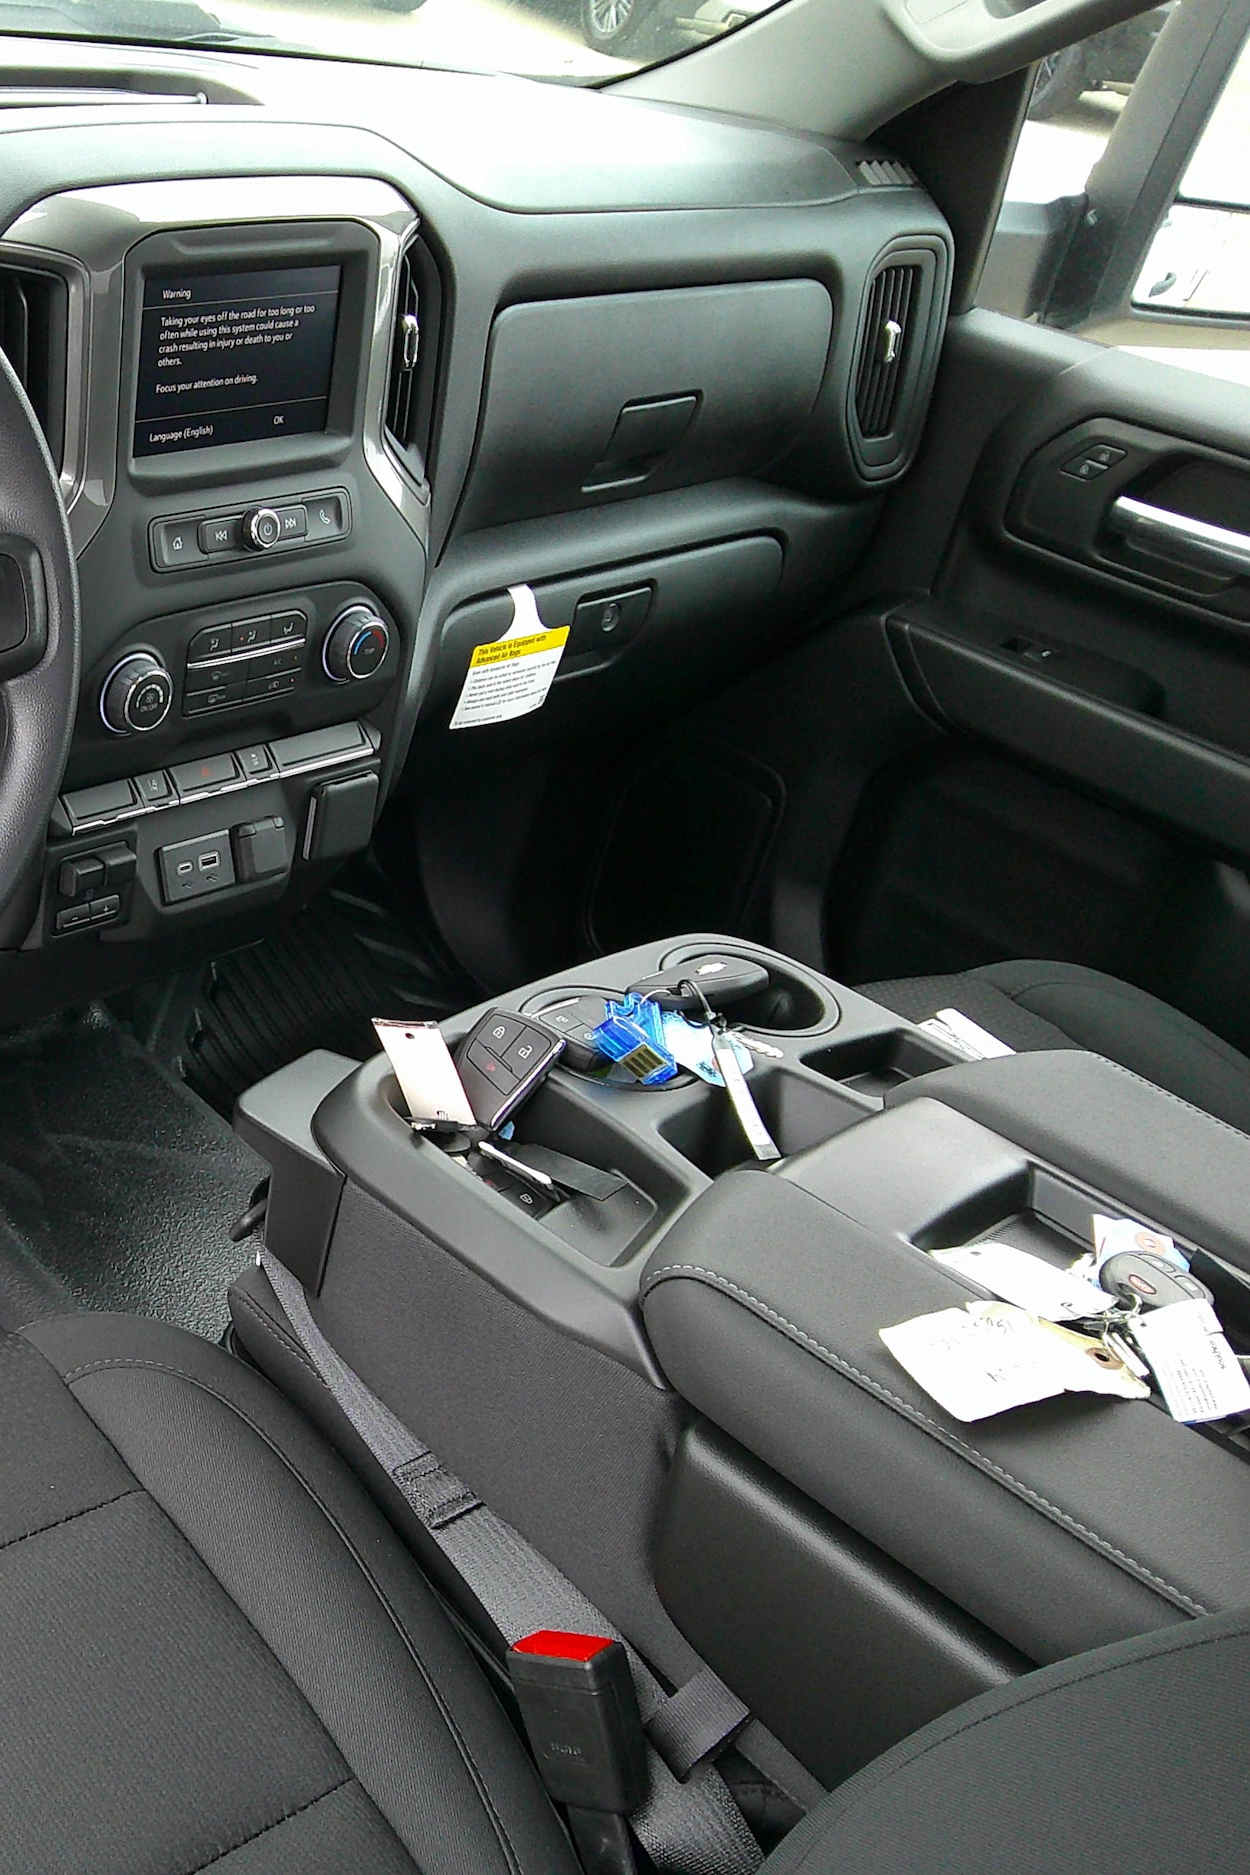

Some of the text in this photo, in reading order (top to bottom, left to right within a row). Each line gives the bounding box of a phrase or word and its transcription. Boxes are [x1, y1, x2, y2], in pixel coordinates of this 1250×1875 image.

[162, 289, 191, 300] Warning
[161, 316, 183, 328] Taking
[184, 316, 200, 327] your
[200, 314, 216, 325] eyes
[217, 310, 228, 321] off
[228, 309, 240, 320] the
[240, 308, 256, 319] road
[257, 307, 267, 317] for
[267, 308, 279, 317] too
[280, 305, 294, 317] long
[303, 305, 315, 313] too
[159, 319, 299, 340] often while using this system could cause a
[158, 332, 293, 354] crash resulting in injury or death to you or
[157, 357, 182, 367] others.
[155, 374, 258, 394] Focus your attention on driving.
[273, 415, 285, 425] OK
[149, 425, 213, 443] Language (English)
[478, 648, 489, 656] This
[489, 643, 507, 655] Vehicle
[513, 637, 535, 648] Equipped
[476, 653, 501, 664] Advanced
